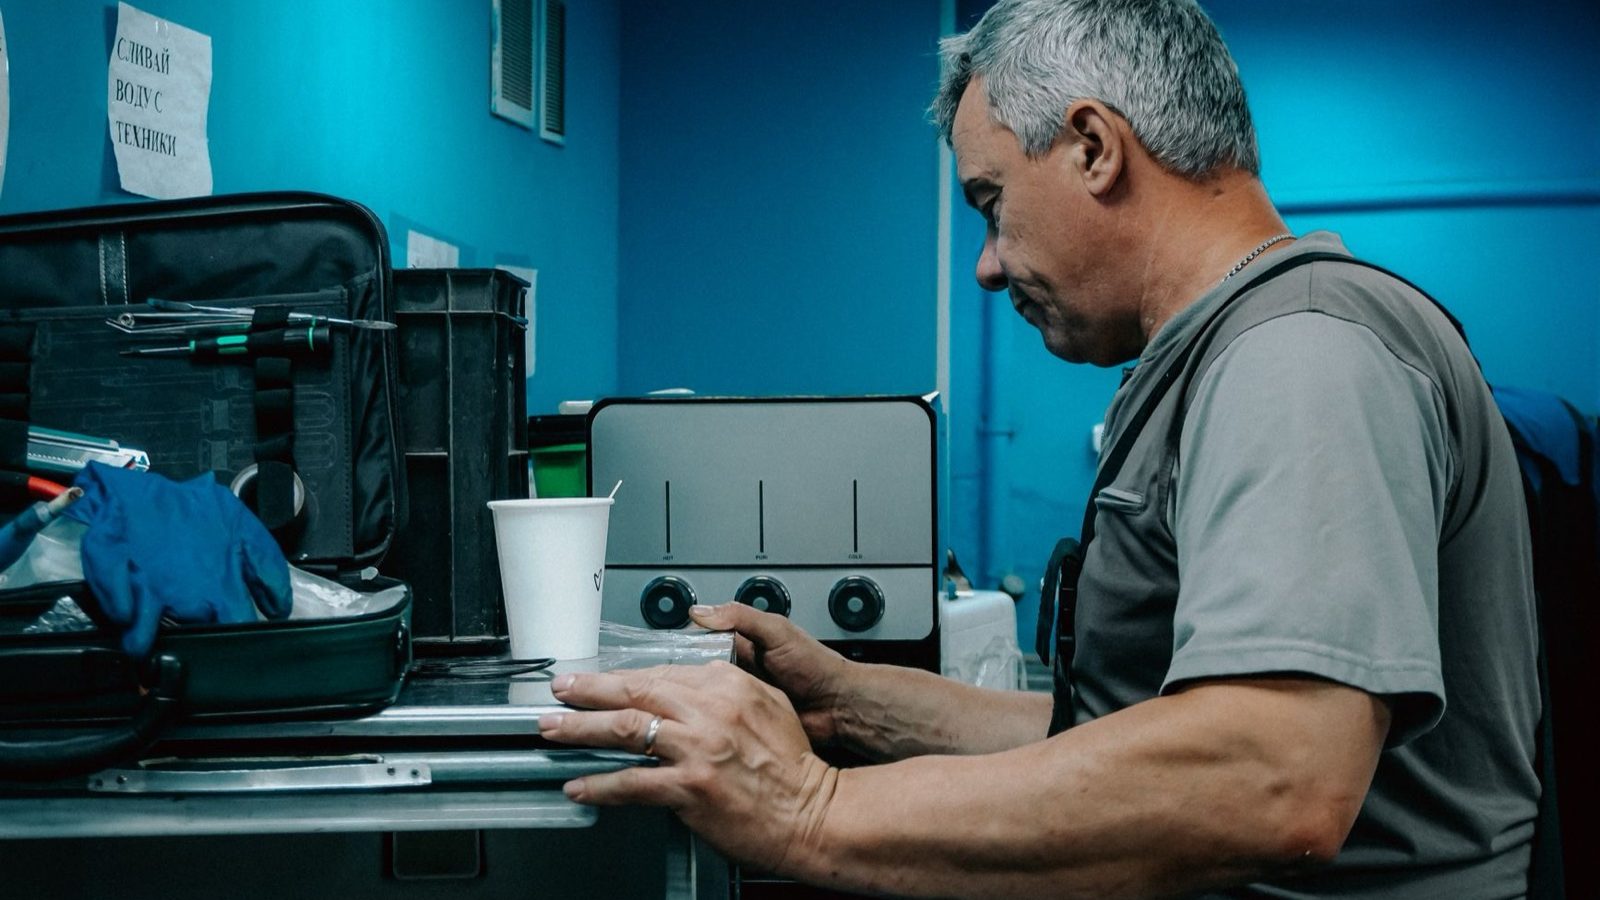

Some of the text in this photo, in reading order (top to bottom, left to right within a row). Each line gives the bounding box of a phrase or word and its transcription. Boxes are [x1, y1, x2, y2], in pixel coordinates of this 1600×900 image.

[117, 37, 171, 75] СЛИВАЙ
[116, 79, 163, 114] ВОДУ С
[116, 120, 176, 157] ТЕХНИКИ
